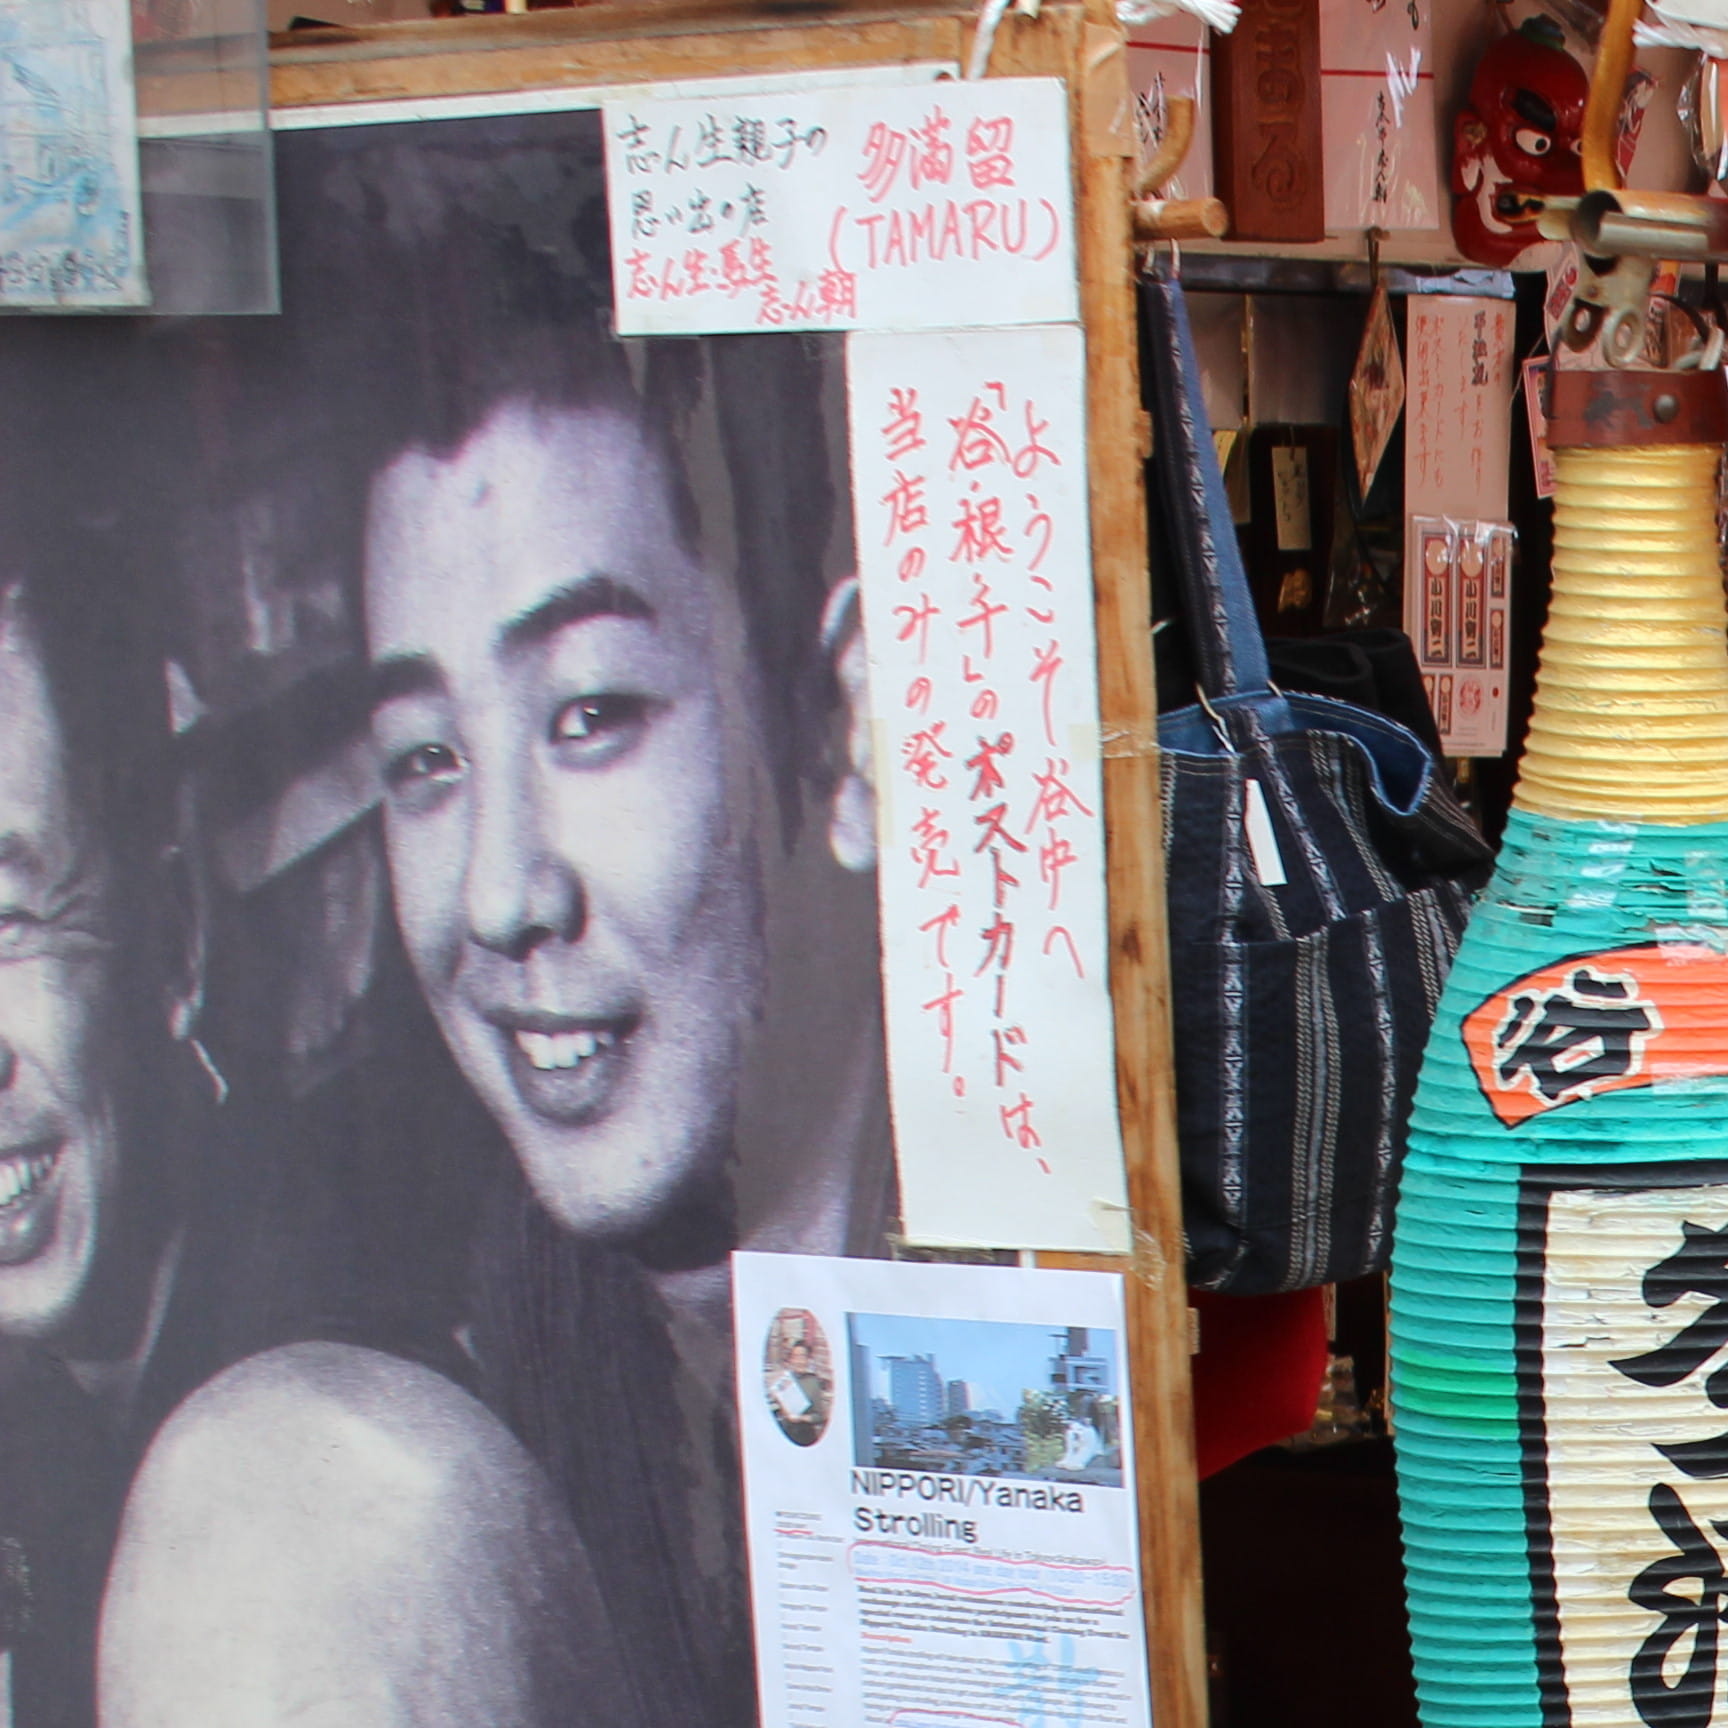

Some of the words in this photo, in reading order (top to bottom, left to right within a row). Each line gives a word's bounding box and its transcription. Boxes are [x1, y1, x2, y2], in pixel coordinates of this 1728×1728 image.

[616, 113, 826, 175] 志ん生親子の
[856, 105, 1015, 202] 多満留
[829, 200, 1060, 268] (TAMARU)
[1011, 401, 1093, 980] ようこそ谷中へ
[878, 387, 964, 1100] 当店のみの発売です。
[850, 1470, 1083, 1514] NIPPORI/Yanaka
[853, 1506, 978, 1543] Strolling
